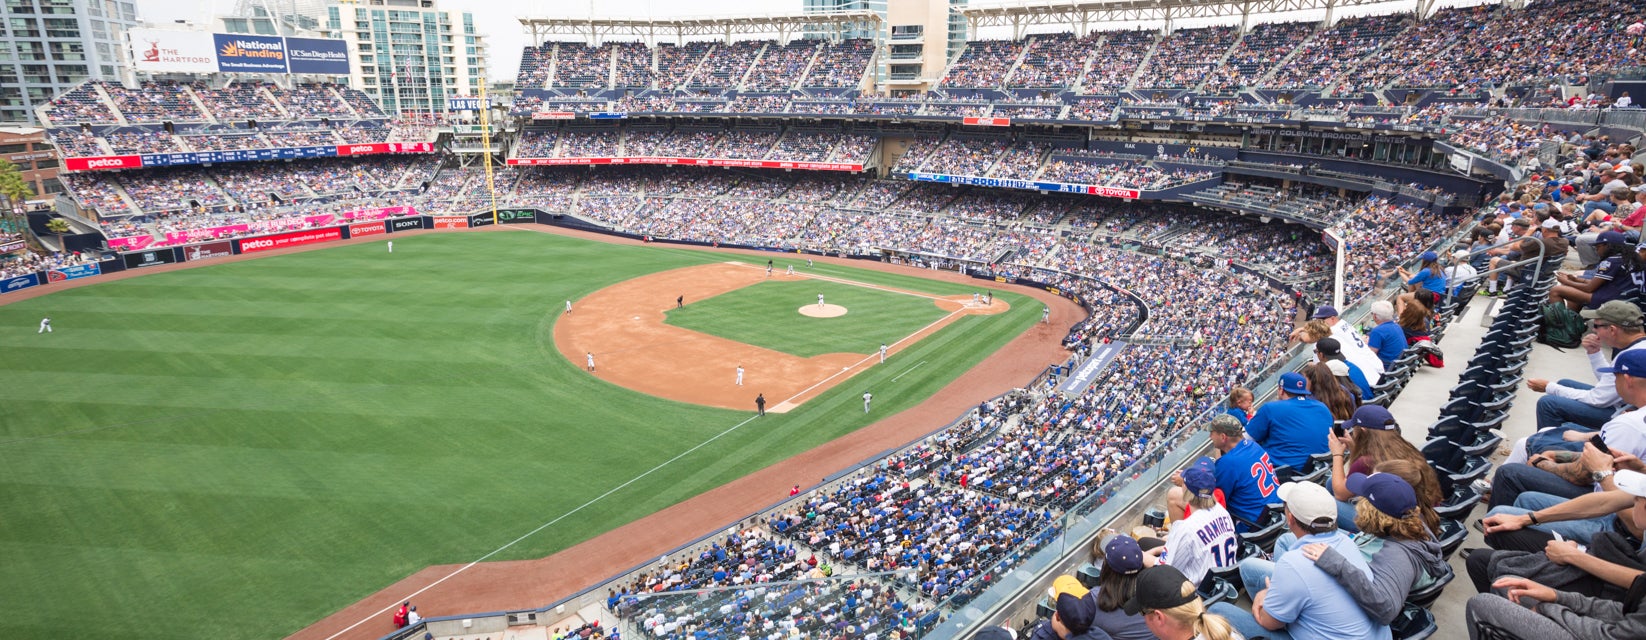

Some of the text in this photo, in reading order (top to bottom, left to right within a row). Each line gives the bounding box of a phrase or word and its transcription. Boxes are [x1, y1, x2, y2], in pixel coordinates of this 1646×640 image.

[237, 40, 282, 50] National
[237, 49, 284, 60] Funding
[311, 51, 328, 59] Diego
[328, 51, 346, 59] Health
[162, 56, 210, 64] HARTFORD
[452, 100, 490, 109] LAS VEGS
[1280, 129, 1319, 138] COLEMAN
[1322, 132, 1372, 141] BROADCAST
[1374, 135, 1406, 143] CENTER
[350, 145, 373, 154] petco
[88, 157, 122, 168] petco
[1105, 188, 1131, 197] TOYOTA
[270, 219, 287, 227] RUN
[395, 220, 418, 228] SONY
[242, 239, 273, 251] petco
[1250, 451, 1280, 498] 25
[1211, 536, 1236, 568] 16
